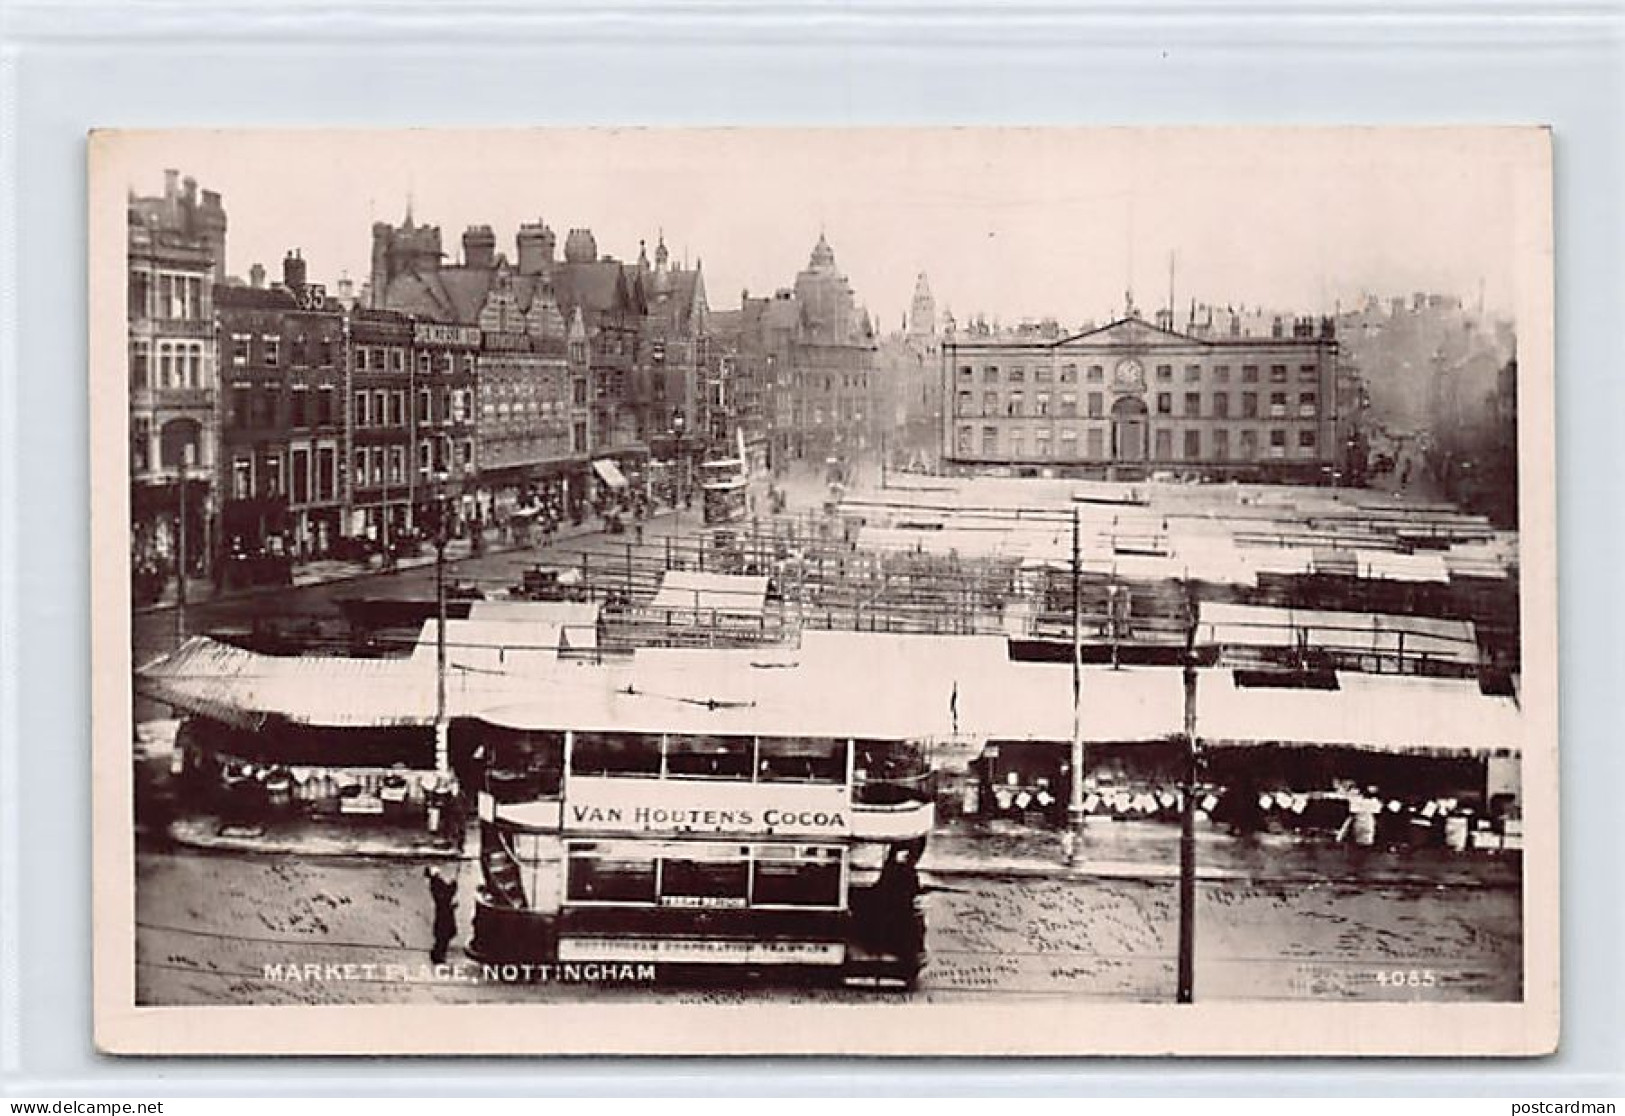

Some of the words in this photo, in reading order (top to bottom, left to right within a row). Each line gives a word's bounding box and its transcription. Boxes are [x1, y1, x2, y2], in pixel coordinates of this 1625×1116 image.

[573, 806, 622, 822] VAN
[635, 807, 753, 824] HOUTEN'S
[763, 809, 845, 827] COCOA
